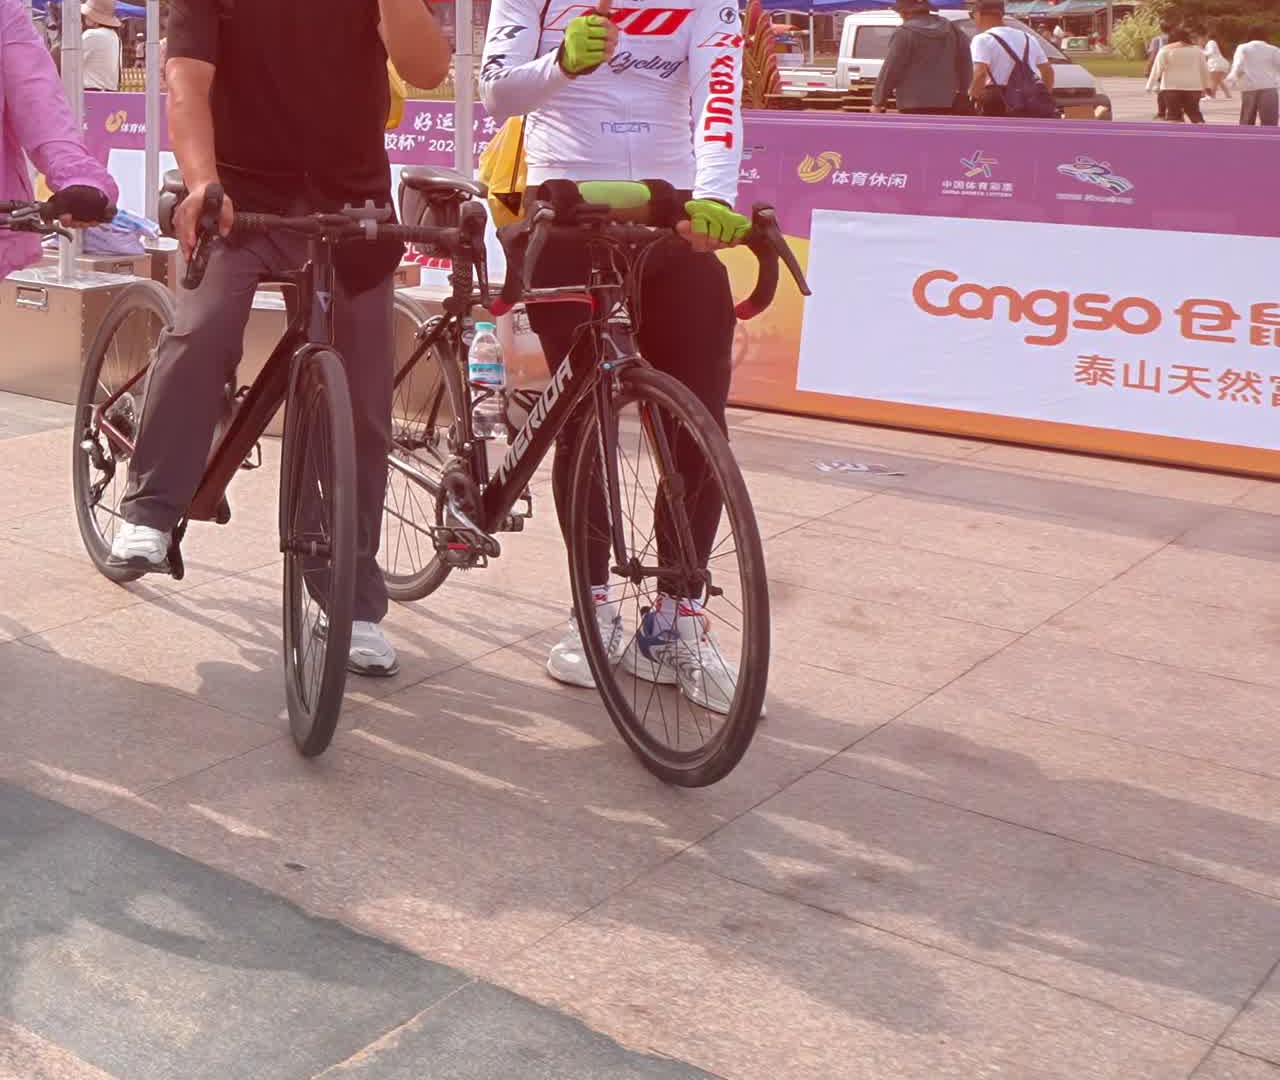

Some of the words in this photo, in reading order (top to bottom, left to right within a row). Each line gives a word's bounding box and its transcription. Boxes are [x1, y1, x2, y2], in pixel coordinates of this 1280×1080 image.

[608, 51, 685, 79] Cycling
[704, 54, 737, 150] KIDULT
[414, 112, 500, 134] 好运东
[832, 170, 907, 188] 体育休闲
[1074, 354, 1280, 408] 泰山天然
[498, 357, 574, 486] MERIDA
